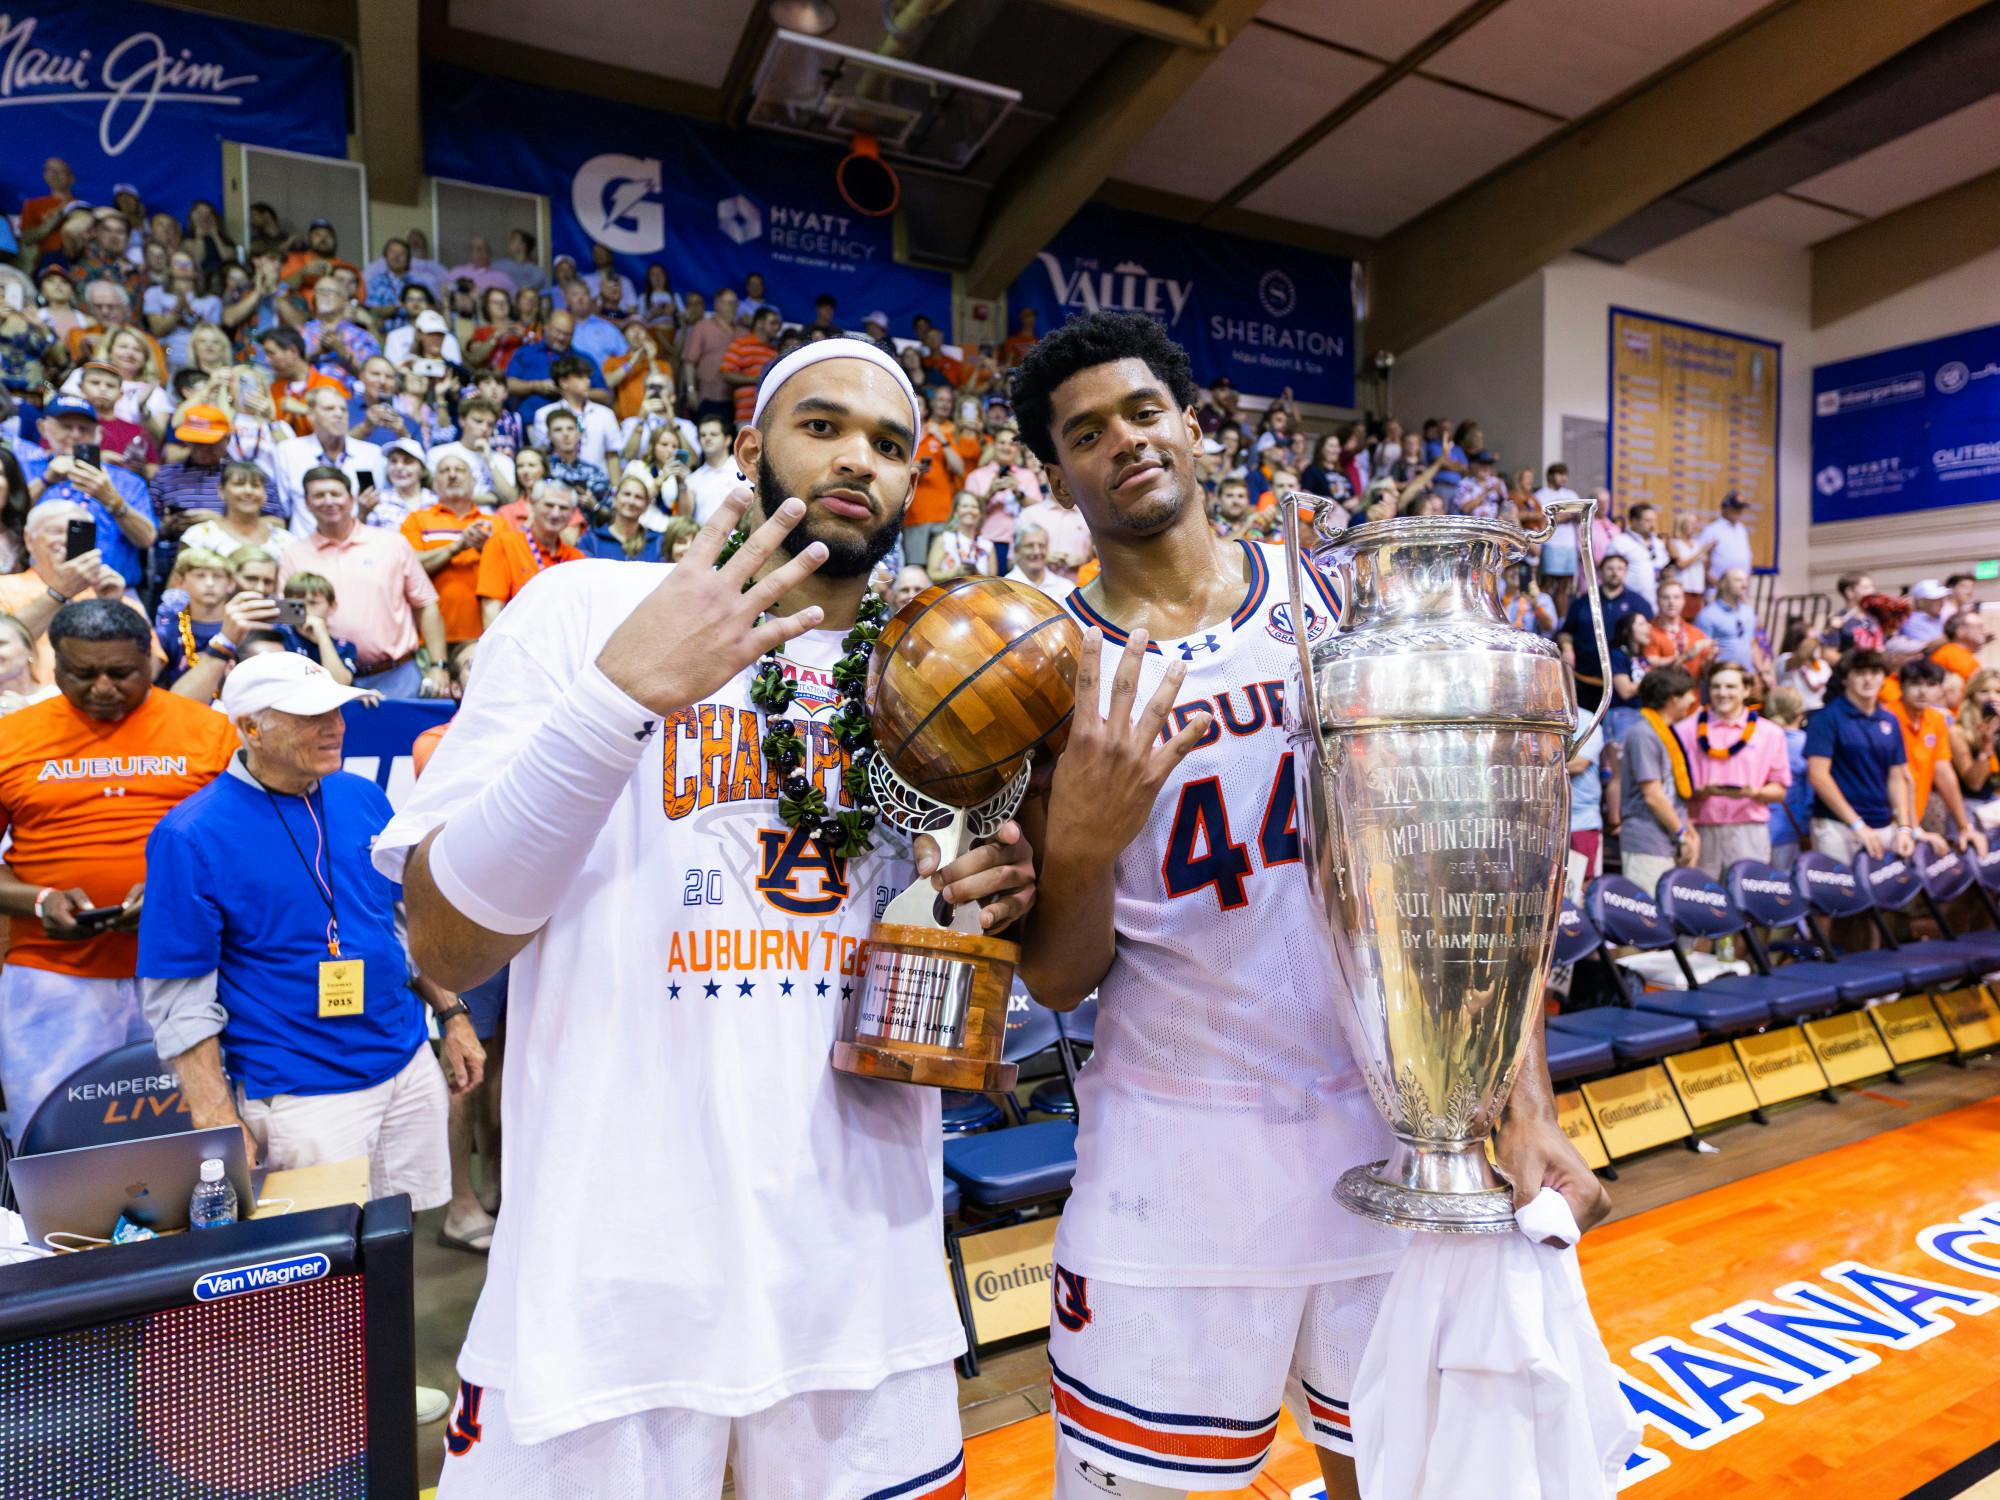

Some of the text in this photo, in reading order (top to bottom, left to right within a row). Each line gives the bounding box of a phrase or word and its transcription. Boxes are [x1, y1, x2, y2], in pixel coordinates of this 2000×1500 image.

[100, 32, 259, 156] Jim
[770, 205, 850, 236] HYATT
[770, 228, 876, 260] REGENCY
[1037, 252, 1194, 327] VALLEY
[1210, 314, 1344, 357] SHERATON
[1274, 625, 1324, 643] GRAATE
[782, 663, 838, 690] MAU
[36, 755, 188, 782] AUBURN
[1366, 817, 1512, 864] AMPIONSHIP
[1449, 862, 1479, 875] FOR
[683, 868, 724, 906] 20
[874, 885, 907, 919] 2
[667, 929, 810, 973] AUBURN
[1401, 929, 1422, 949] BY
[891, 965, 950, 981] INVTATIONAL
[876, 1014, 918, 1030] VALUABLE
[891, 1005, 911, 1016] 2024
[1681, 1070, 1733, 1099] Continental
[1599, 1095, 1662, 1130] Continental
[206, 1260, 322, 1295] Van Wagner
[974, 1261, 1054, 1302] Contine
